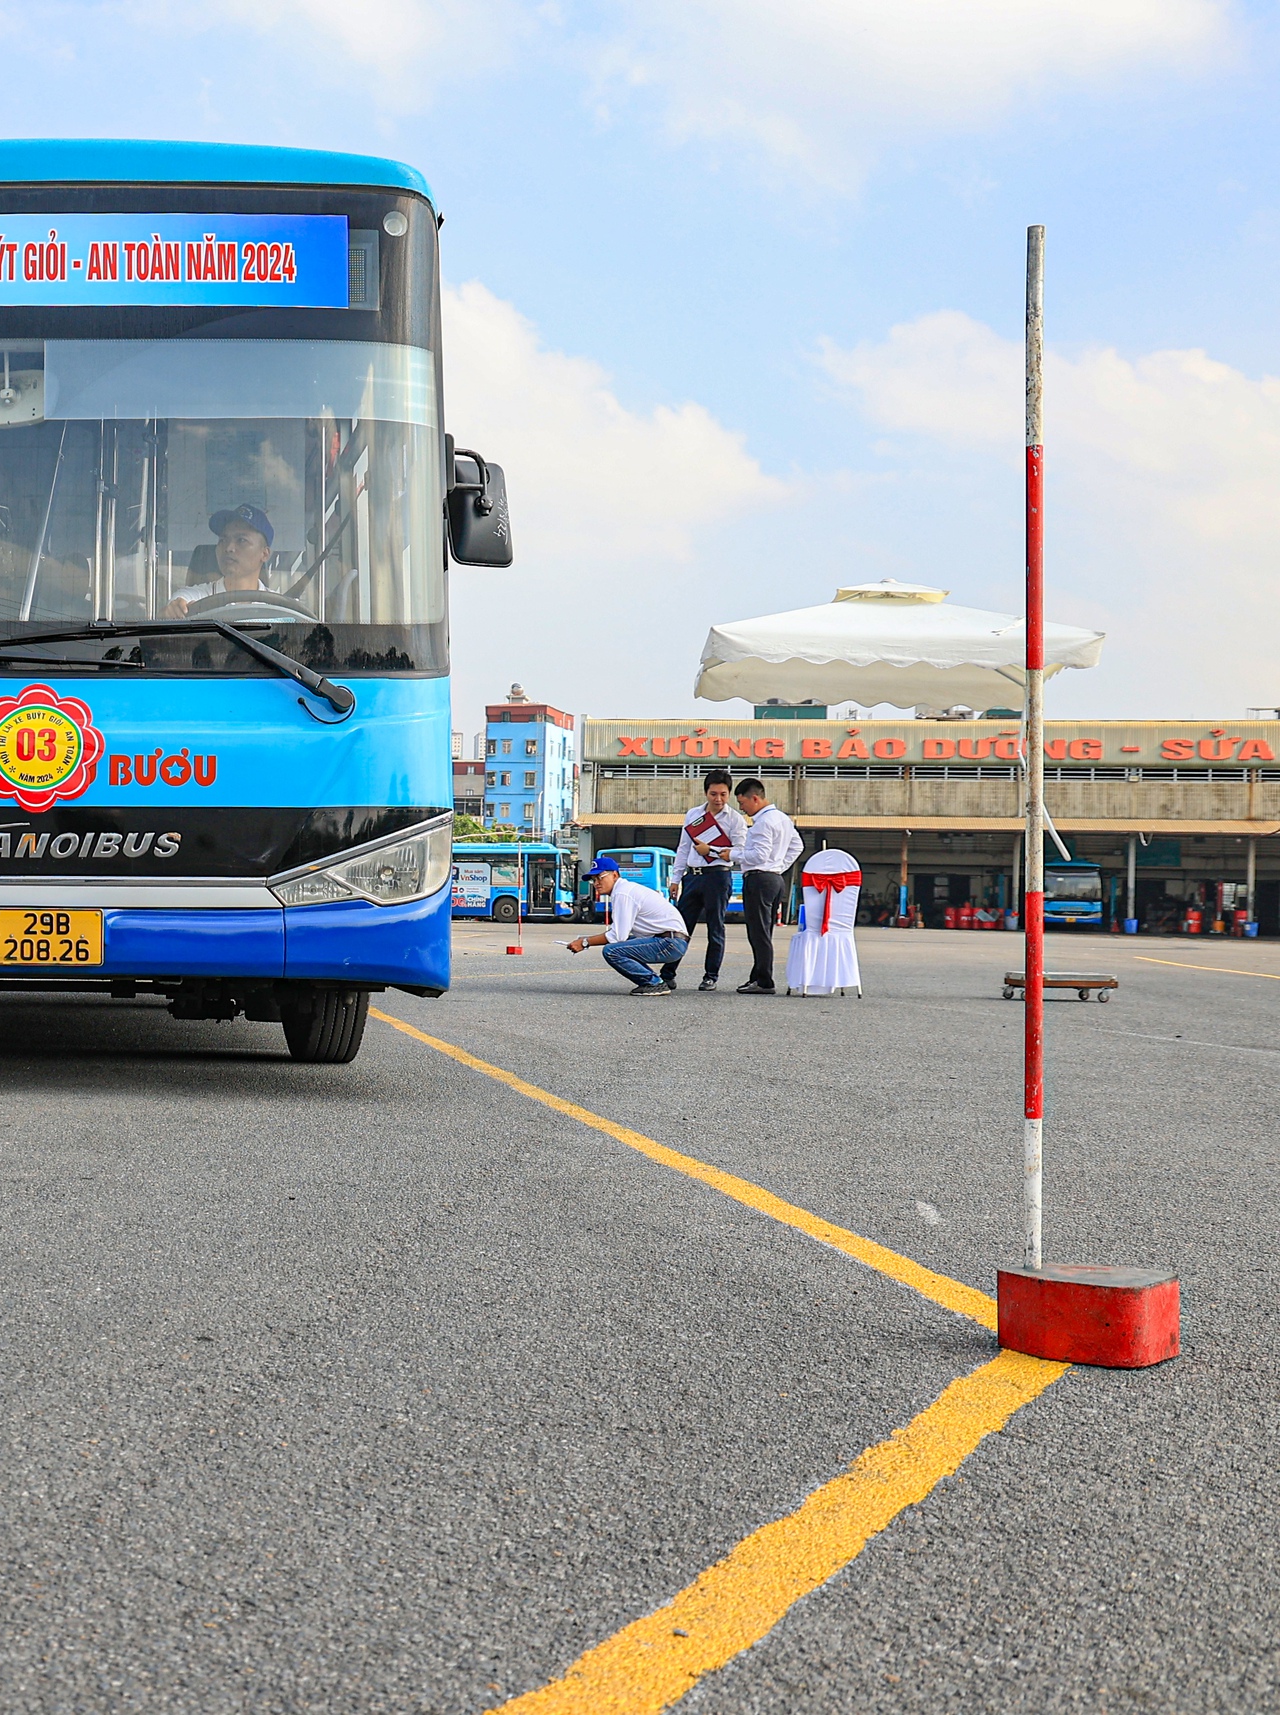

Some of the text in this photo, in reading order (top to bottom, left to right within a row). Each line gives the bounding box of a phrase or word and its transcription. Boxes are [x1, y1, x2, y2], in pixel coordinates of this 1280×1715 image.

[24, 229, 66, 282] GIỎI
[87, 243, 117, 281] AN
[124, 234, 180, 282] TOÀN
[187, 234, 237, 281] NĂM
[242, 243, 296, 282] 2024
[13, 715, 24, 725] XE
[26, 710, 46, 721] BUÝT
[2, 723, 14, 734] LÁI
[65, 730, 75, 742] AN
[16, 728, 57, 762] 03
[617, 727, 786, 758] XƯỞNG
[801, 728, 907, 759] BẢO
[922, 729, 1103, 760] DƯỠNG
[1160, 729, 1276, 761] SỬA
[0, 751, 10, 764] HỘI
[62, 745, 75, 766] TOÀN
[19, 771, 54, 784] NĂM 2024
[24, 912, 71, 936] 29B
[3, 938, 90, 962] 208.26
